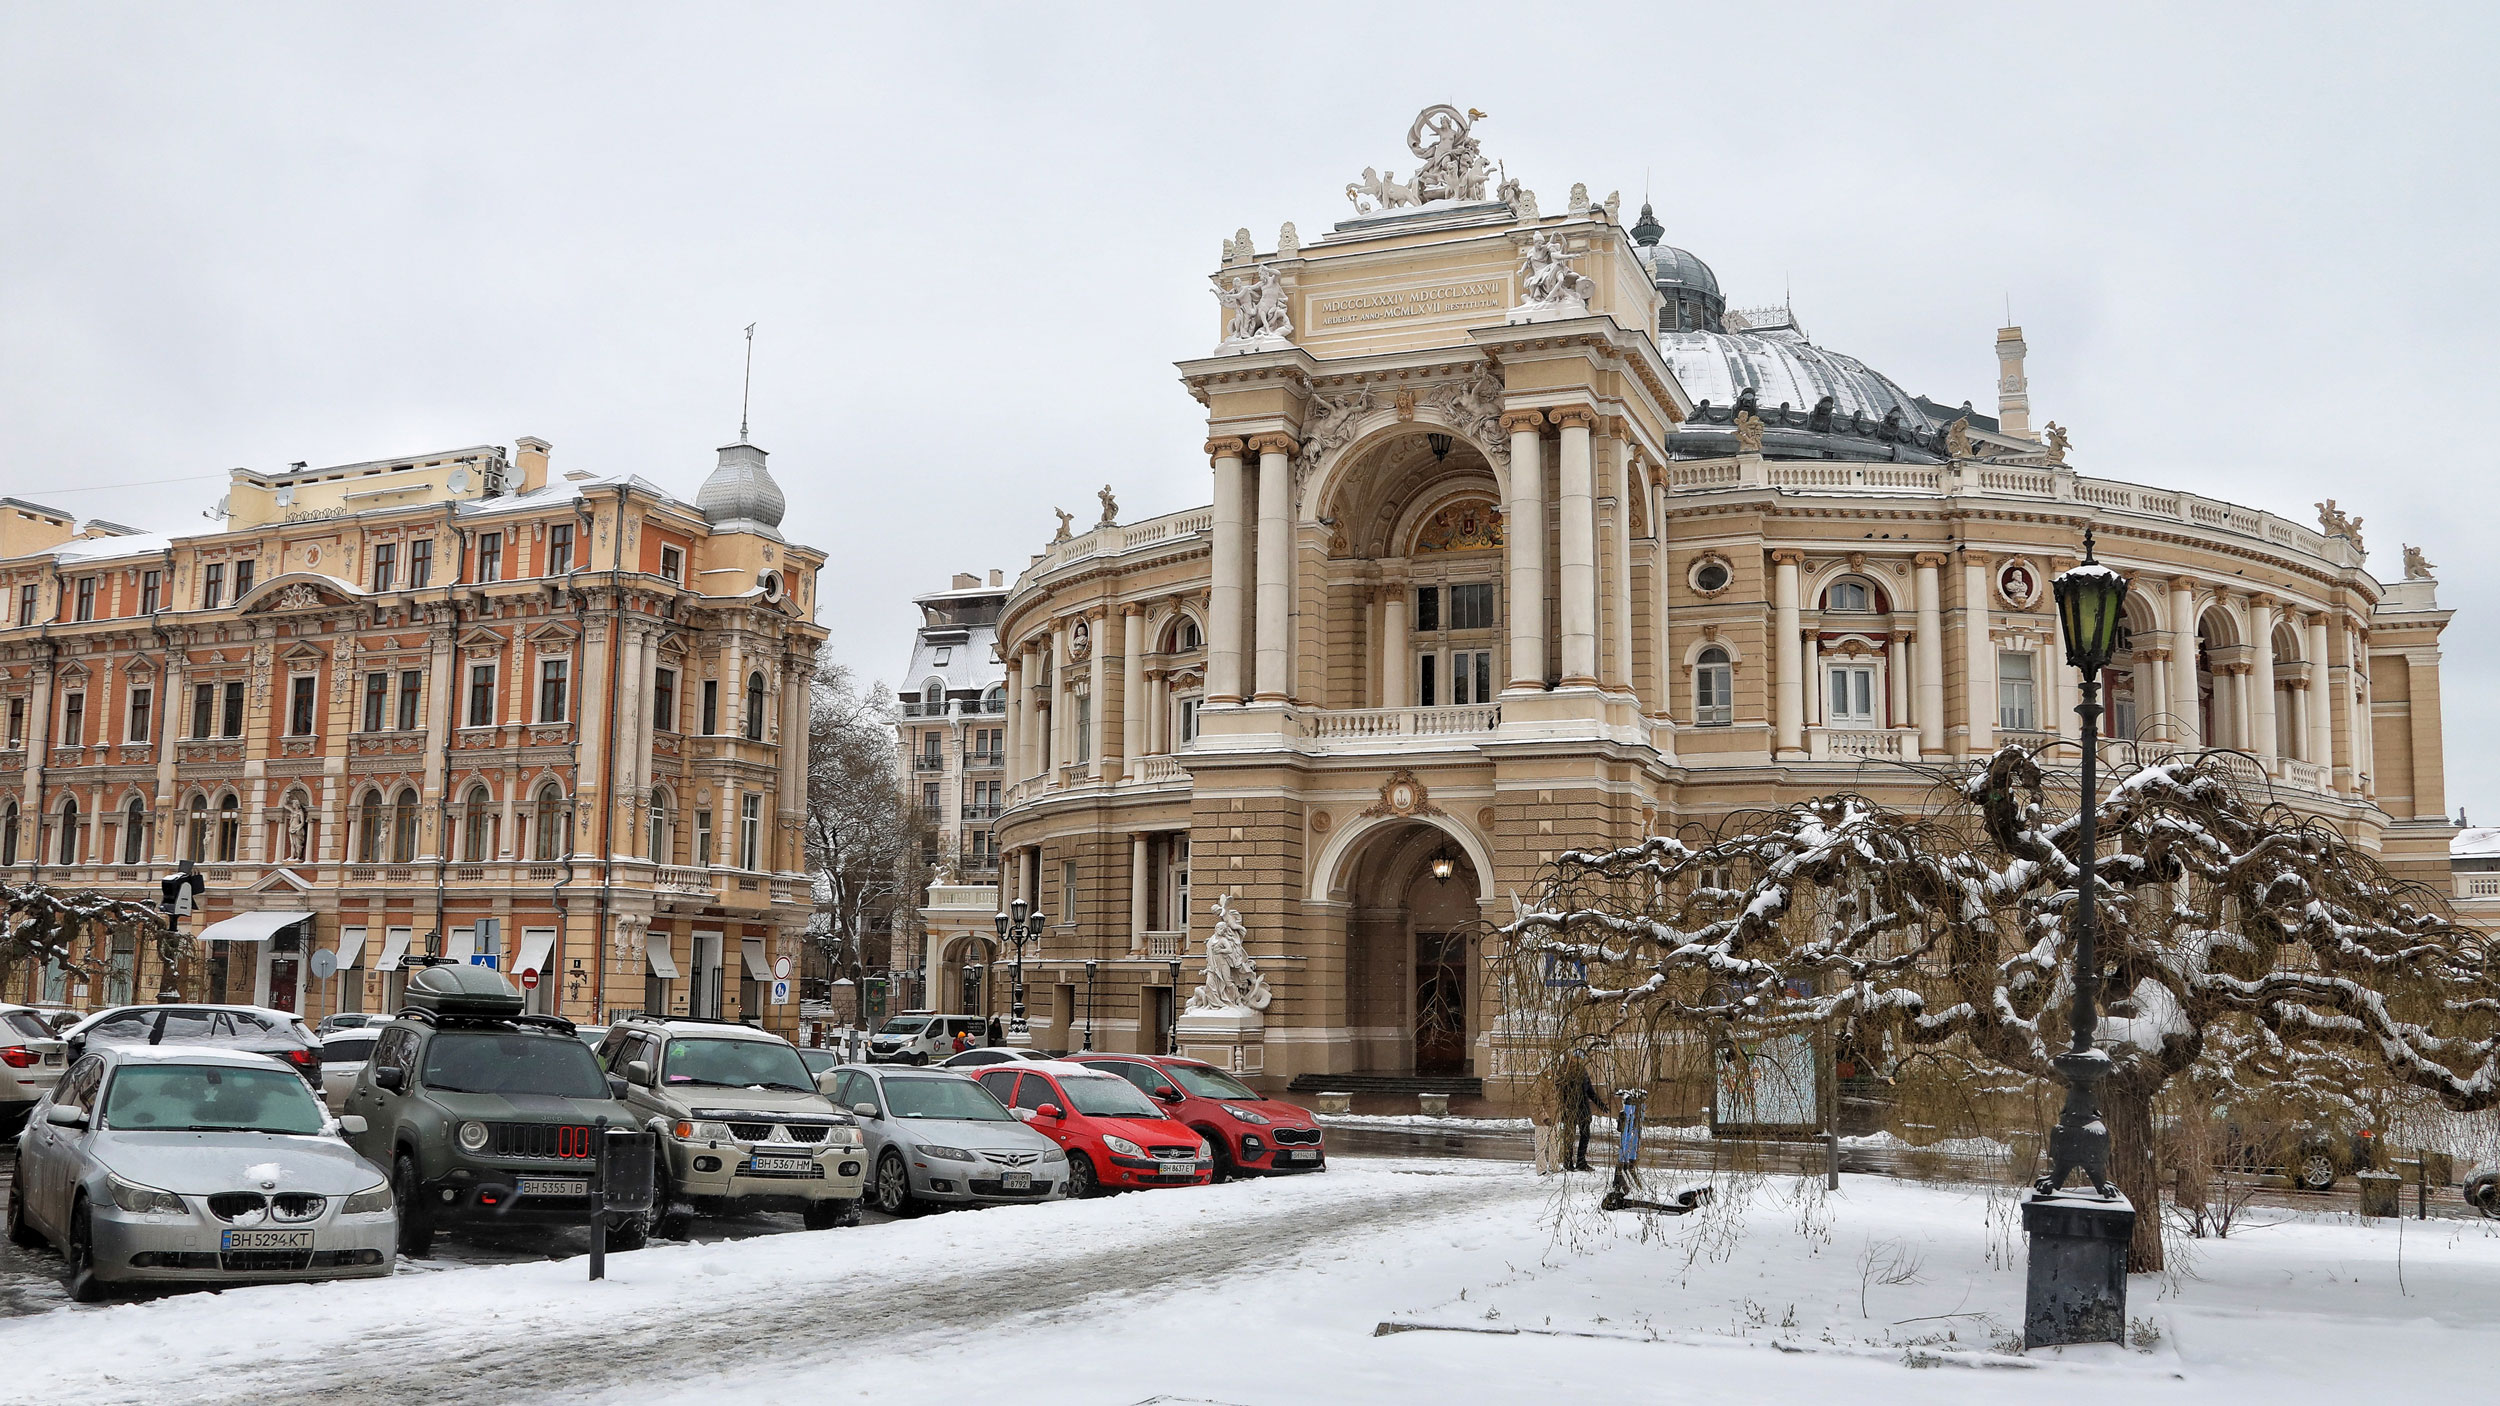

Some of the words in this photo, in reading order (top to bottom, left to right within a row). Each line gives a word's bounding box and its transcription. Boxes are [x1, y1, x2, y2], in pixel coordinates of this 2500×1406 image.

[1322, 293, 1405, 313] MDCCCLXXXIV
[1409, 282, 1499, 303] MDCCCLXXXVII
[1445, 299, 1499, 311] RESTITUTUM
[773, 1159, 795, 1169] 5367
[541, 1182, 566, 1193] 5355
[231, 1233, 252, 1247] BH
[254, 1233, 286, 1247] 5294
[289, 1233, 309, 1247] KT
